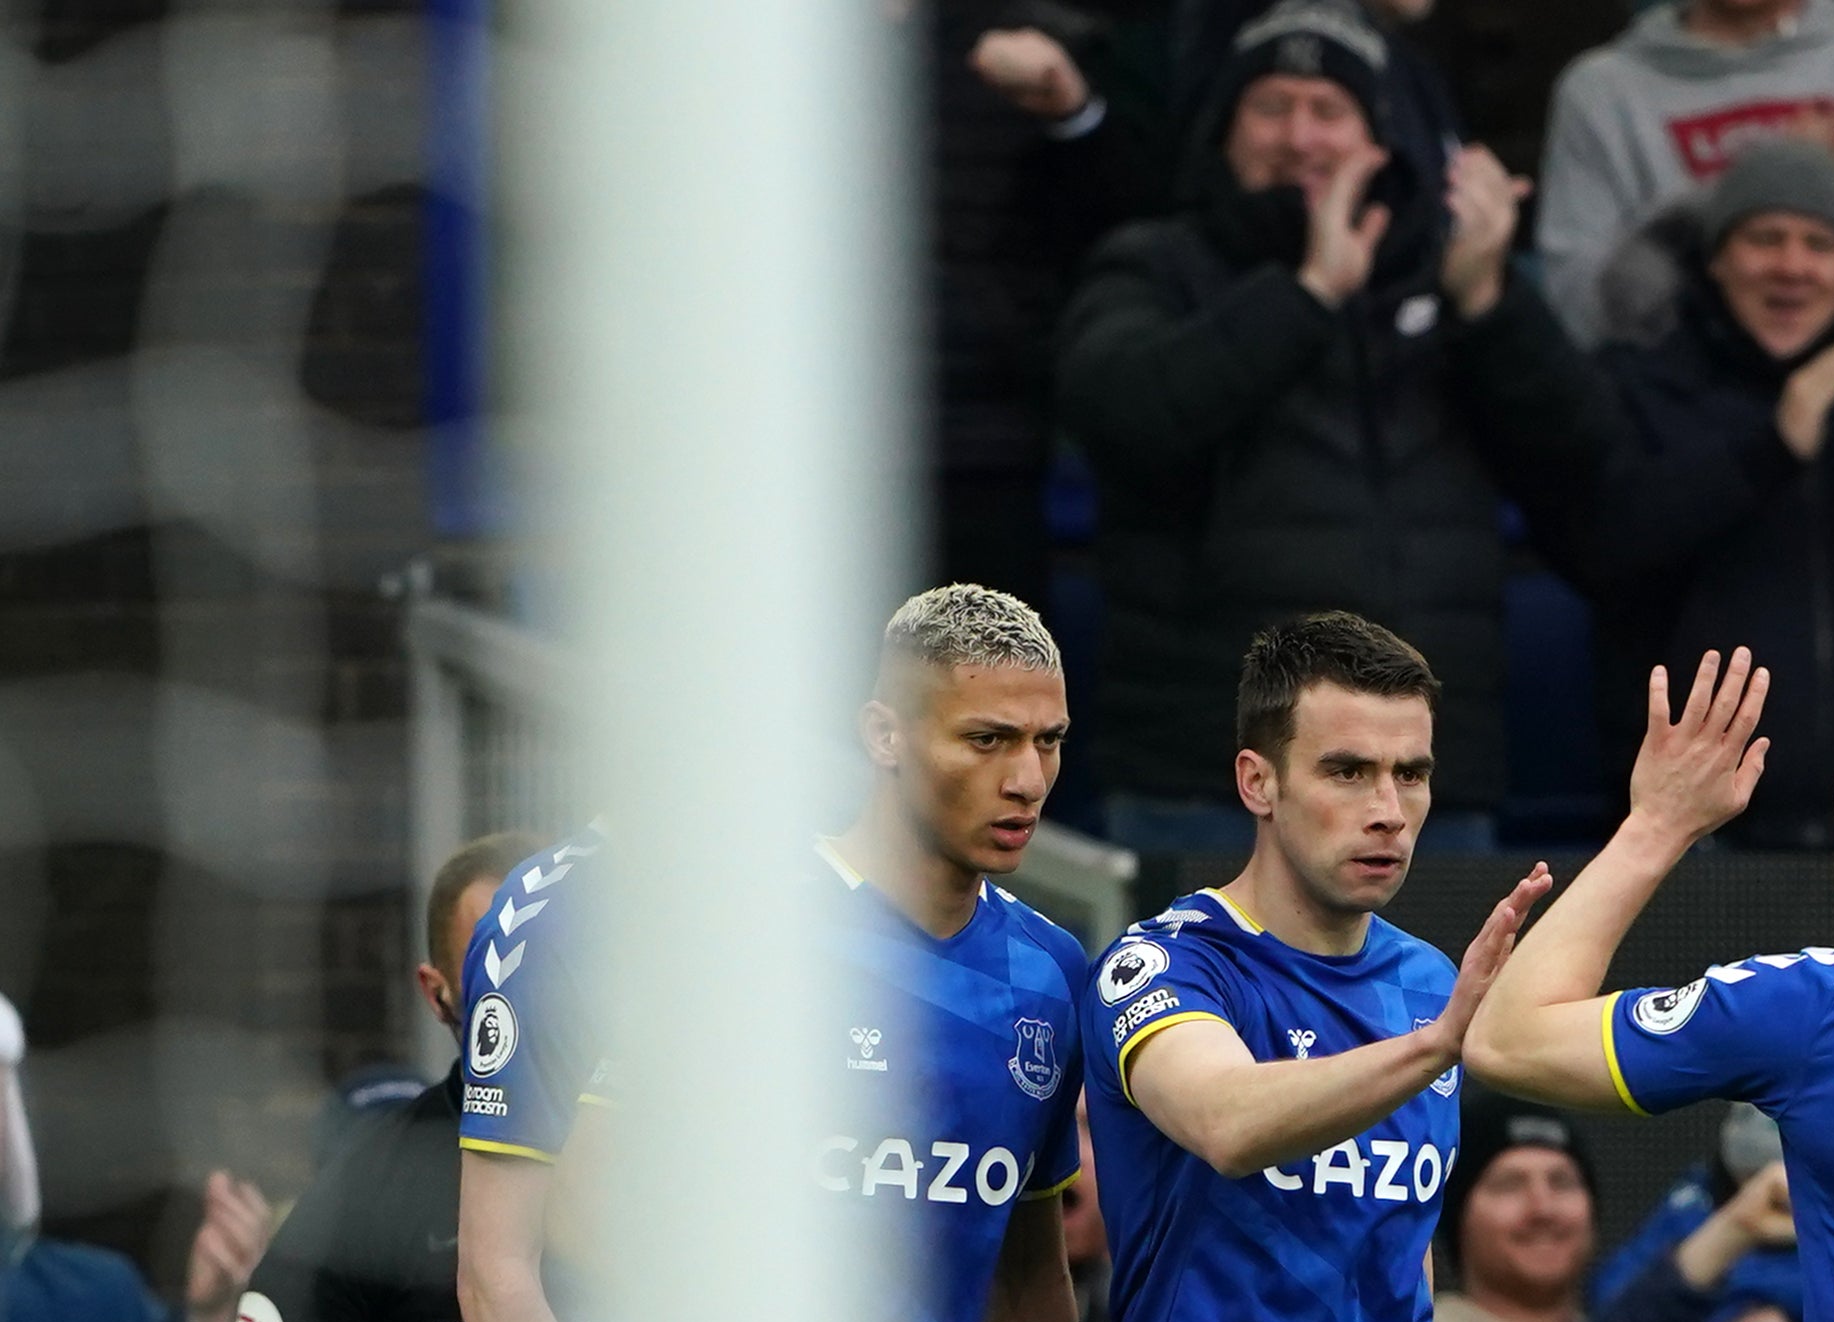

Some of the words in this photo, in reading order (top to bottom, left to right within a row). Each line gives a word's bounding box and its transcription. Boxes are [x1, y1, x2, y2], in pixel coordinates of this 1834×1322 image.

[1125, 989, 1169, 1020] room
[1128, 997, 1180, 1030] racism
[847, 1057, 888, 1071] hummel
[813, 1134, 1036, 1207] CAZO
[1263, 1138, 1456, 1203] AZO
